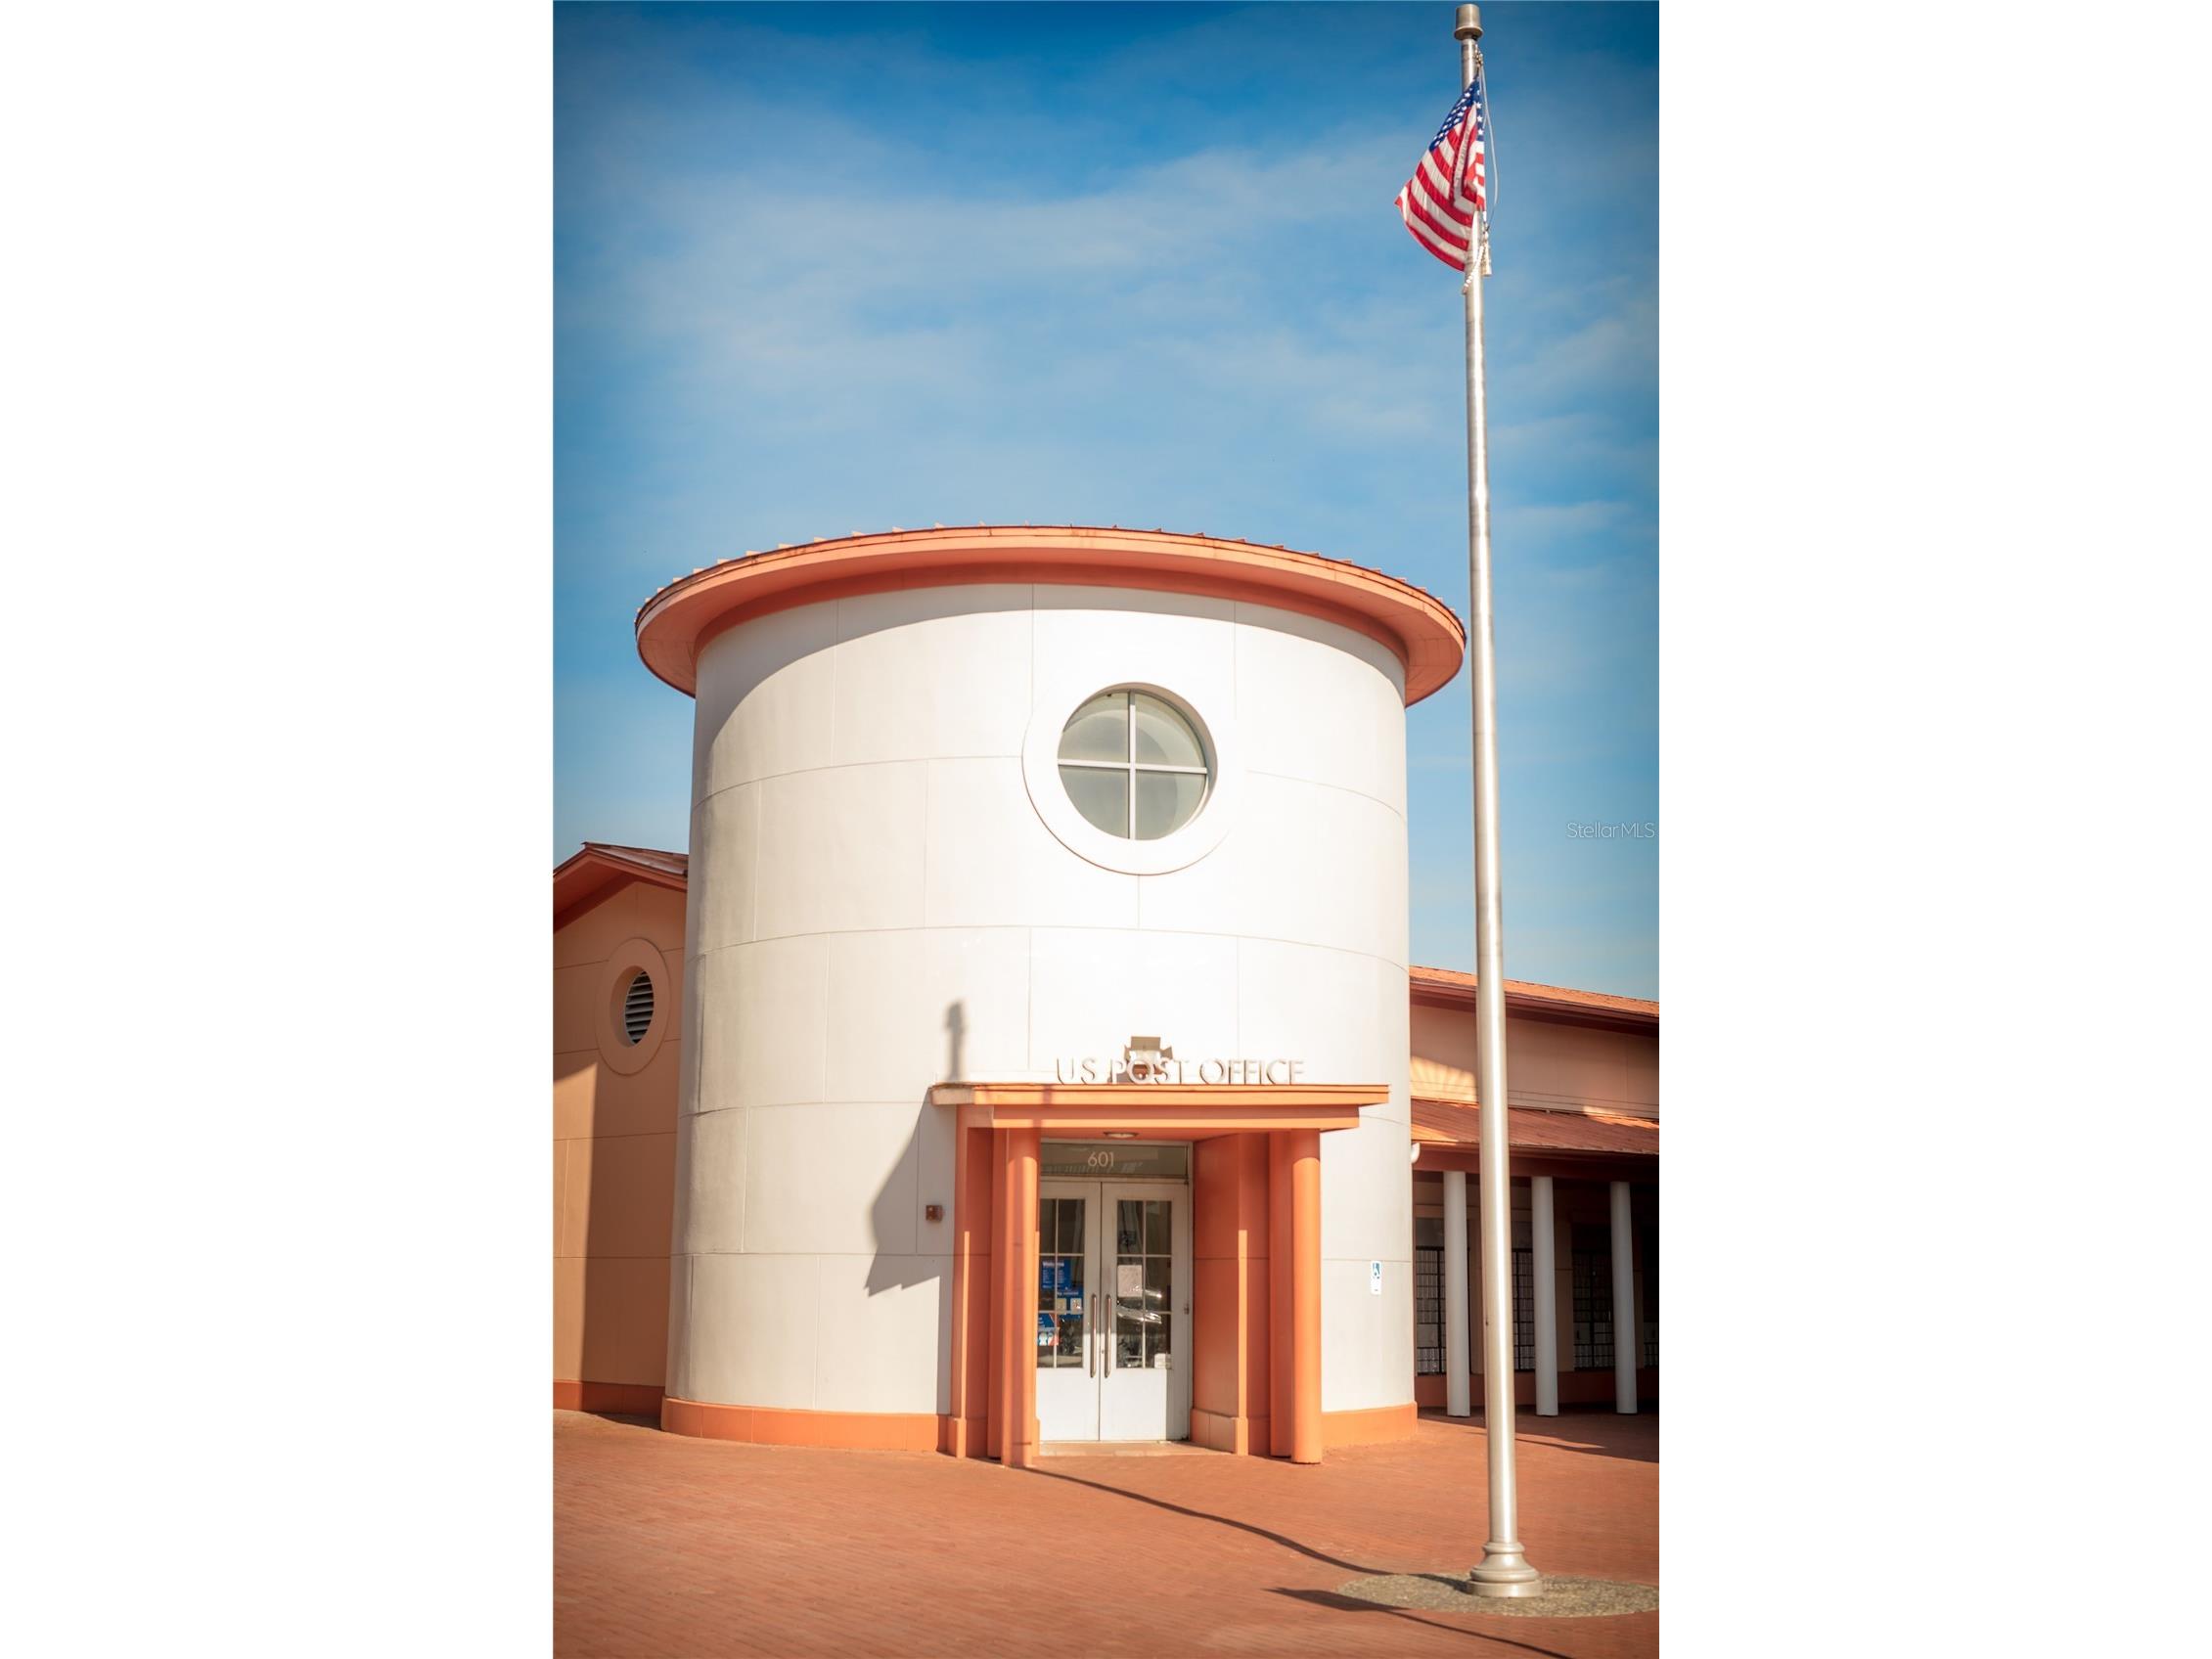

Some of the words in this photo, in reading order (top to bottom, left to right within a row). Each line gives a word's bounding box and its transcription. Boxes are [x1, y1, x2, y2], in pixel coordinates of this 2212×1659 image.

[1056, 1057, 1097, 1085] US
[1109, 1058, 1190, 1085] POST
[1198, 1058, 1305, 1085] OFFICE
[1087, 1151, 1115, 1168] 601
